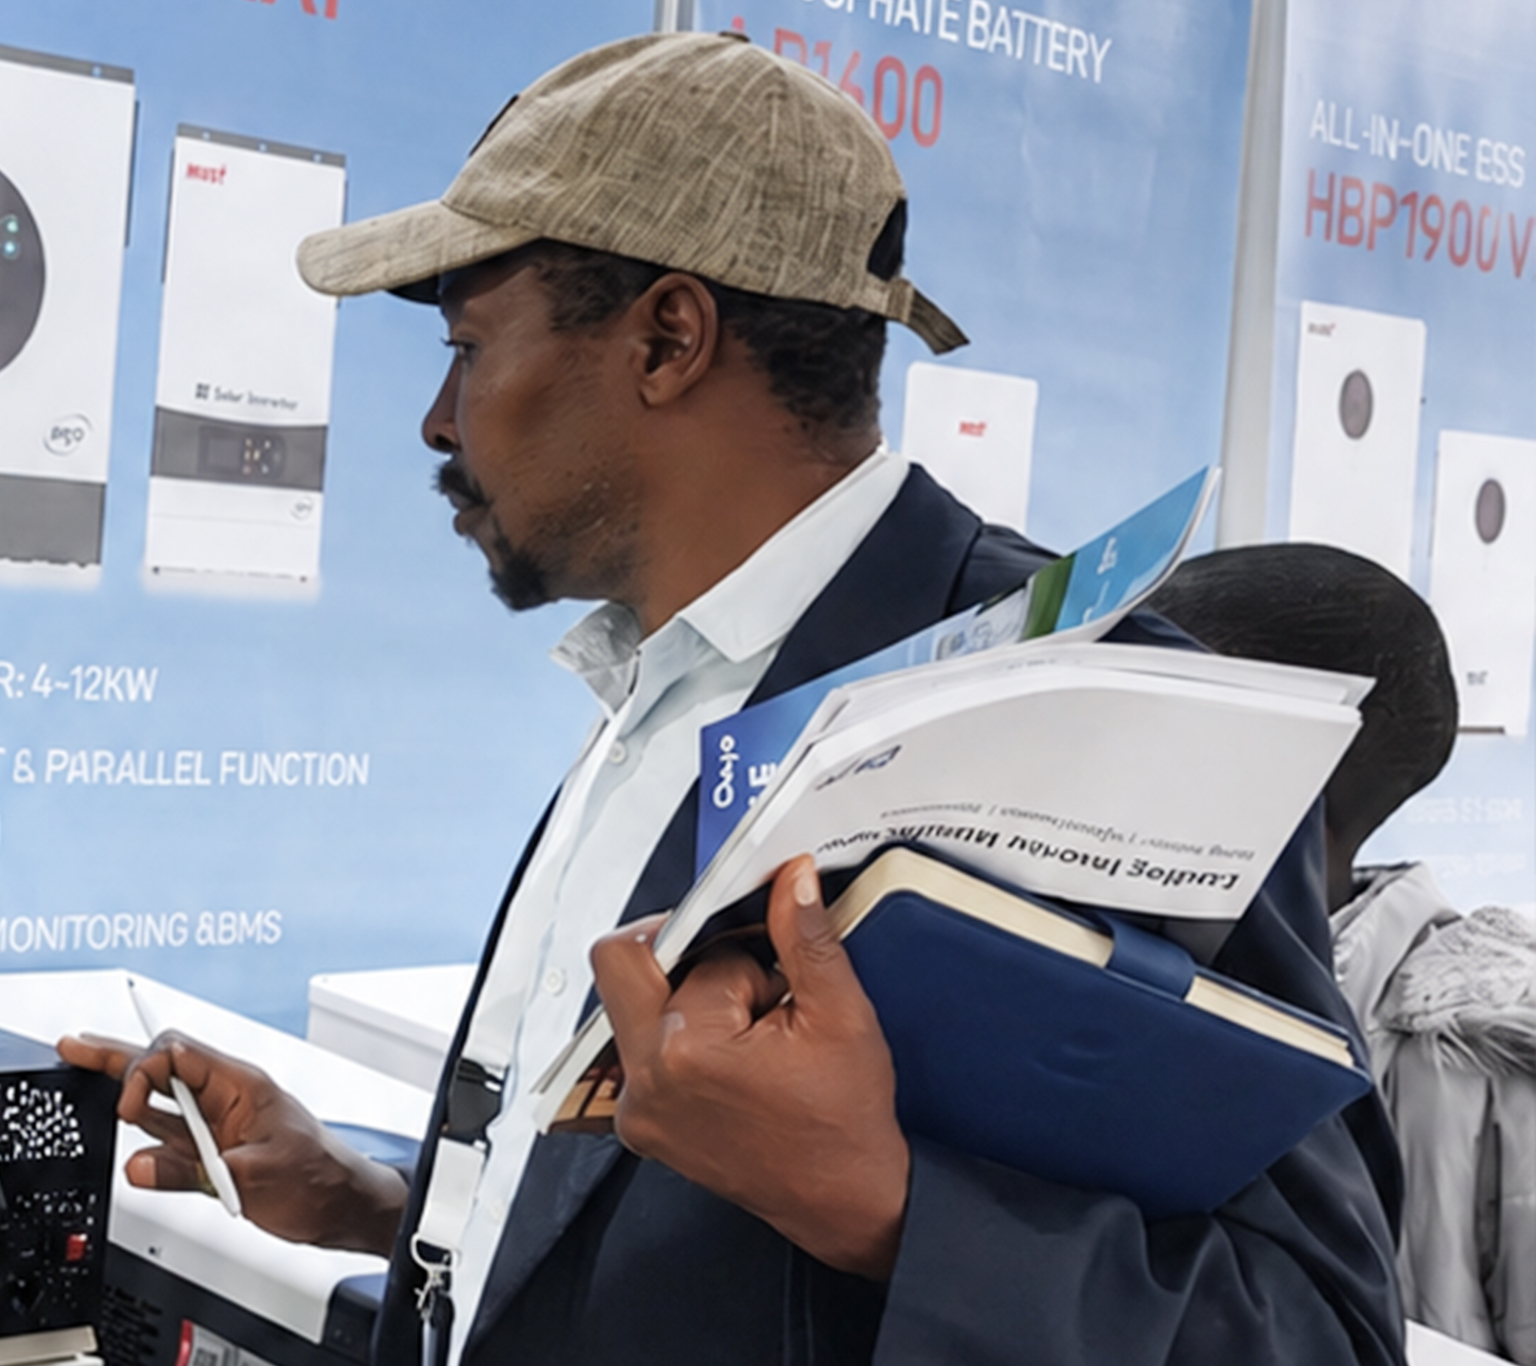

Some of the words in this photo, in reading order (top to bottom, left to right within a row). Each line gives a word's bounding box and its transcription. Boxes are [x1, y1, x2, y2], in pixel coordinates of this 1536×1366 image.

[1310, 99, 1471, 176] ALL-IN-ONE
[1475, 137, 1525, 188] ESS
[13, 748, 36, 784] &
[45, 748, 211, 786] PARALLEL
[219, 751, 369, 786] FUNCTION
